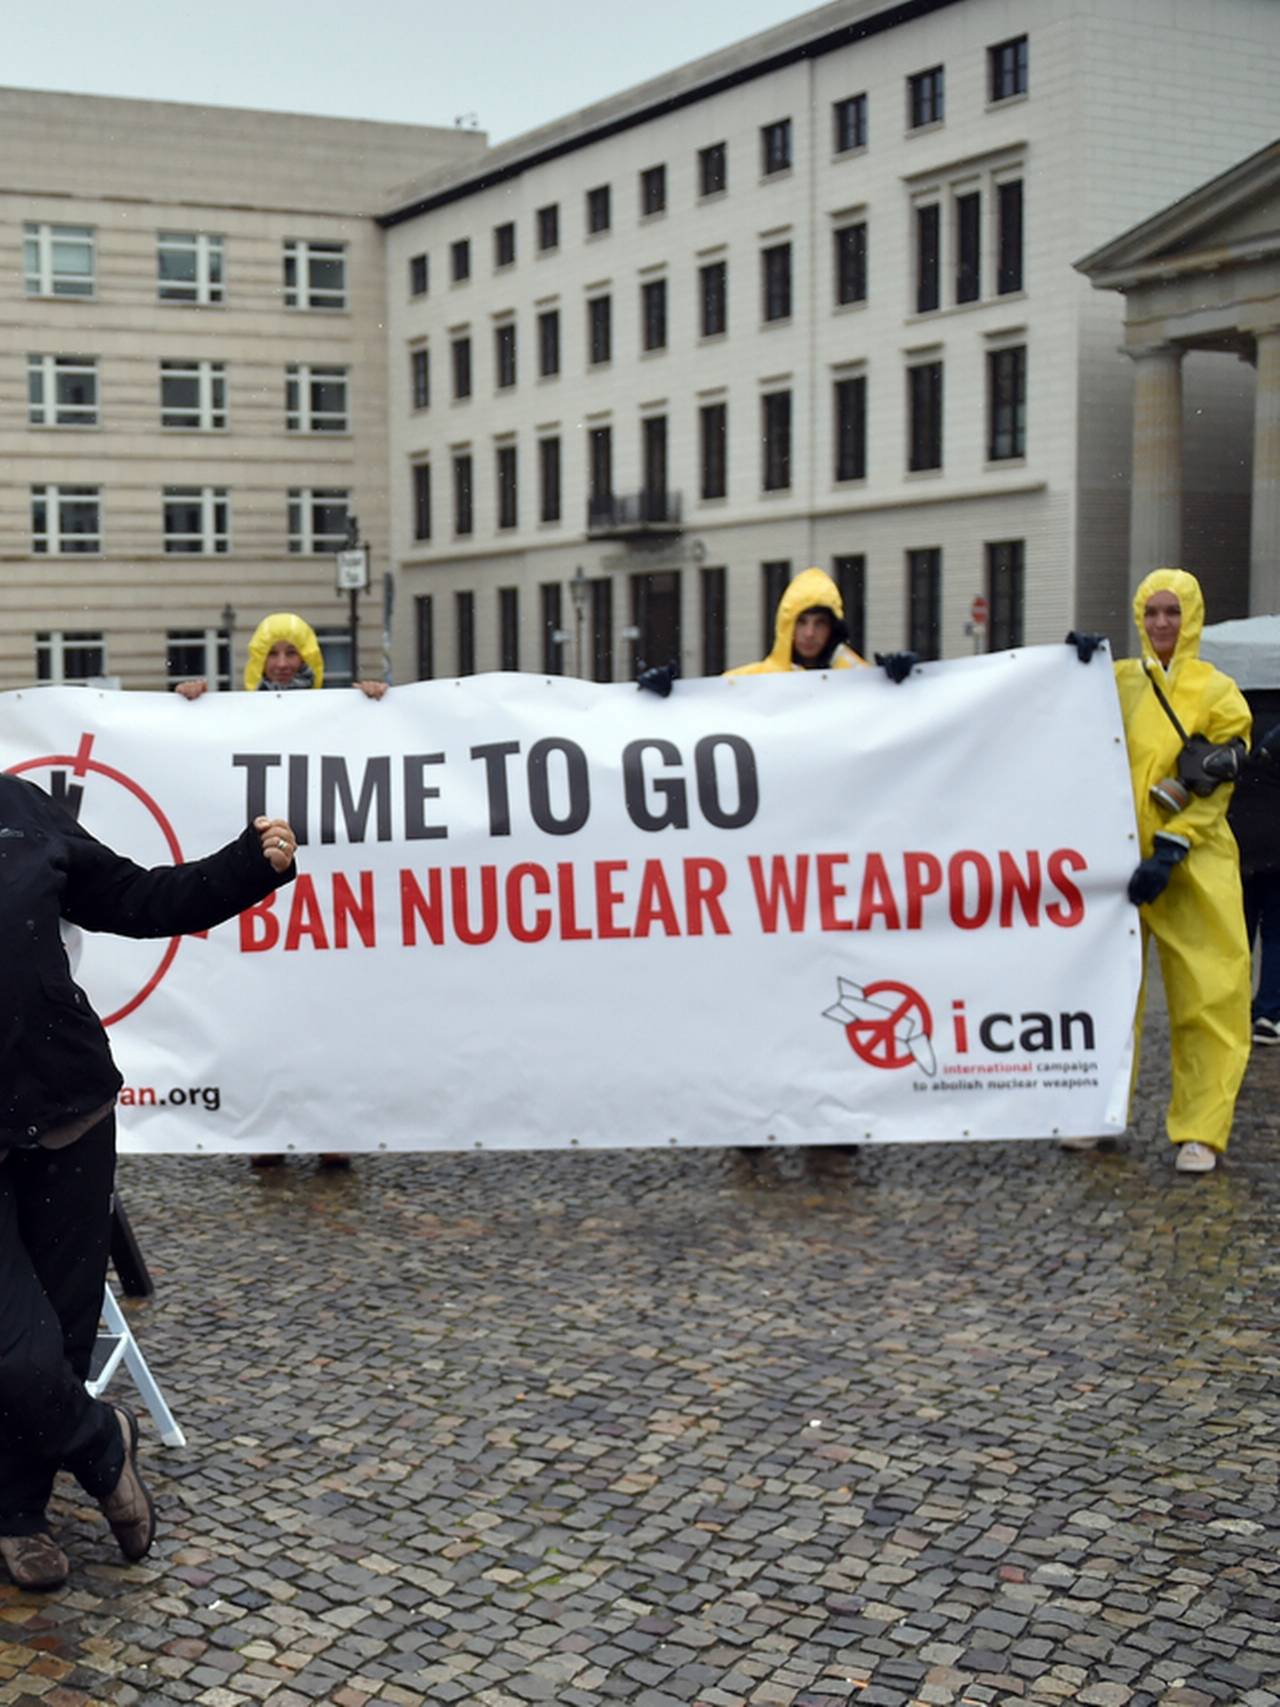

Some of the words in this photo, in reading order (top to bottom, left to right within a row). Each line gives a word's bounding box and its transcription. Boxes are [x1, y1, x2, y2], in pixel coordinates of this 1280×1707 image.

[232, 752, 449, 846] TIME
[470, 736, 591, 836] TO
[621, 733, 760, 832] GO
[238, 870, 376, 952] BAN
[399, 857, 732, 946] NUCLEAR
[747, 847, 1088, 935] WEAPONS
[913, 1080, 928, 1092] to
[932, 1080, 984, 1091] abolish
[987, 1079, 1038, 1090] nuclear
[1043, 1077, 1099, 1089] weapons
[943, 1061, 1033, 1075] international
[1036, 1060, 1098, 1073] campaign
